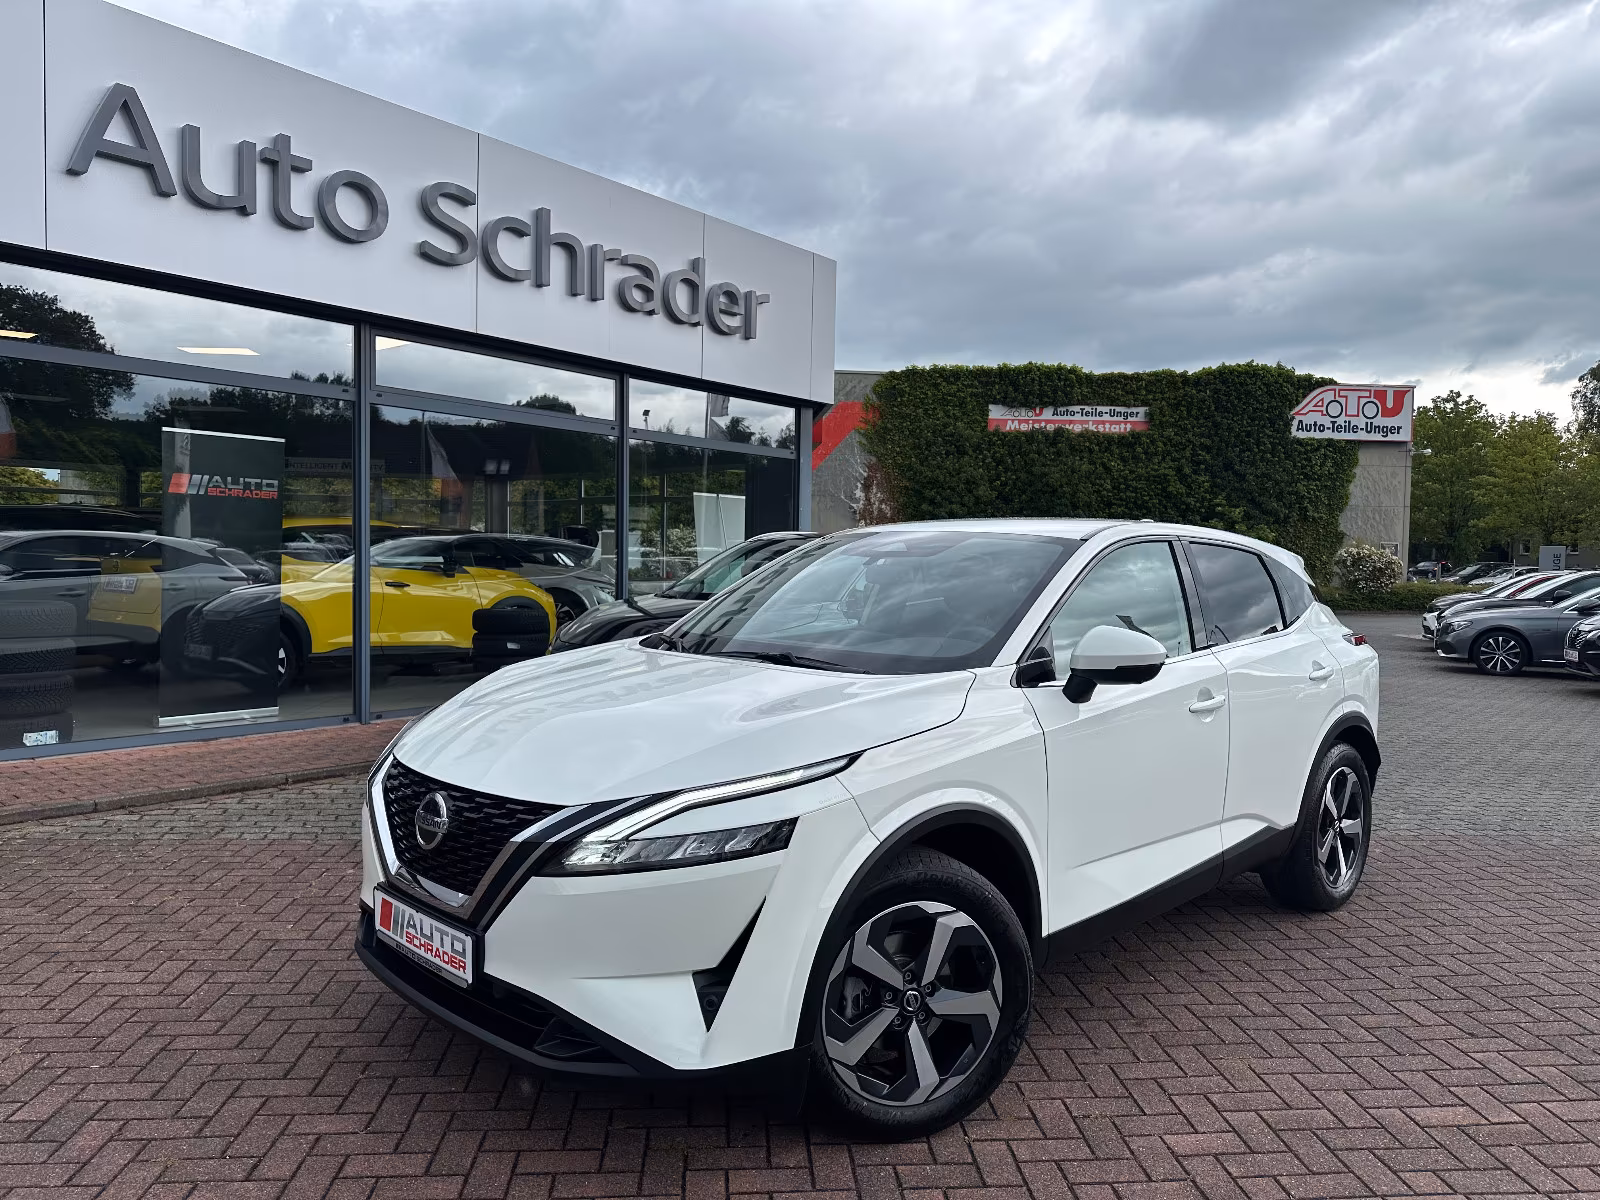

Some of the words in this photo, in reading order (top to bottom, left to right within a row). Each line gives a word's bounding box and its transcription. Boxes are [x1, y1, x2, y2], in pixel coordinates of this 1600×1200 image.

[66, 82, 389, 243] Auto
[419, 181, 770, 340] Schrader
[1051, 407, 1140, 420] Auto-Teile-Unger
[1295, 419, 1403, 438] Auto-Teile-Unger
[208, 475, 279, 491] AUTO
[207, 487, 278, 499] SCHRADER
[405, 912, 467, 960] AUTO
[405, 930, 467, 975] SCHRADER
